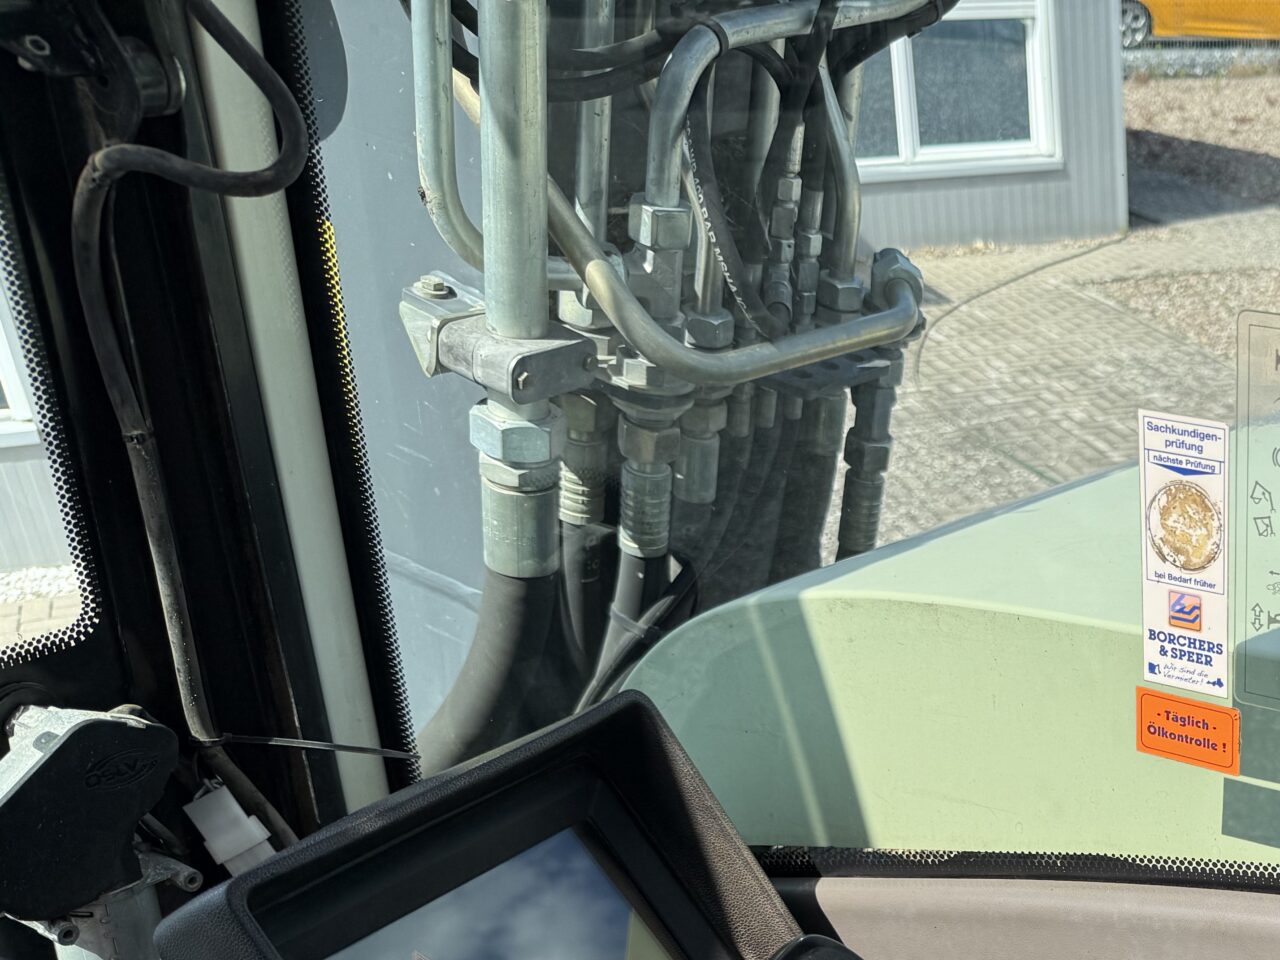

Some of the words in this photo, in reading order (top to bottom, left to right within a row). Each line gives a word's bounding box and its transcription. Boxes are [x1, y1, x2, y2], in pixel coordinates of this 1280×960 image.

[700, 206, 716, 244] BAR
[1146, 421, 1222, 442] Sachkundigen-
[1165, 439, 1203, 455] prüfung
[1153, 455, 1184, 466] nächste
[1185, 460, 1216, 473] Prüfung
[1154, 572, 1166, 580] bei
[1167, 573, 1193, 585] Bedarf
[1193, 578, 1216, 589] früher
[1148, 628, 1224, 655] BORCHERS
[1159, 645, 1169, 657] &
[1170, 647, 1214, 667] SPEER
[1163, 662, 1176, 671] Wir
[1179, 666, 1195, 676] sind
[1197, 670, 1209, 678] die
[1163, 671, 1204, 686] Vermieter!
[1164, 710, 1210, 731] Täglich
[1146, 721, 1218, 751] Ölkontrolle
